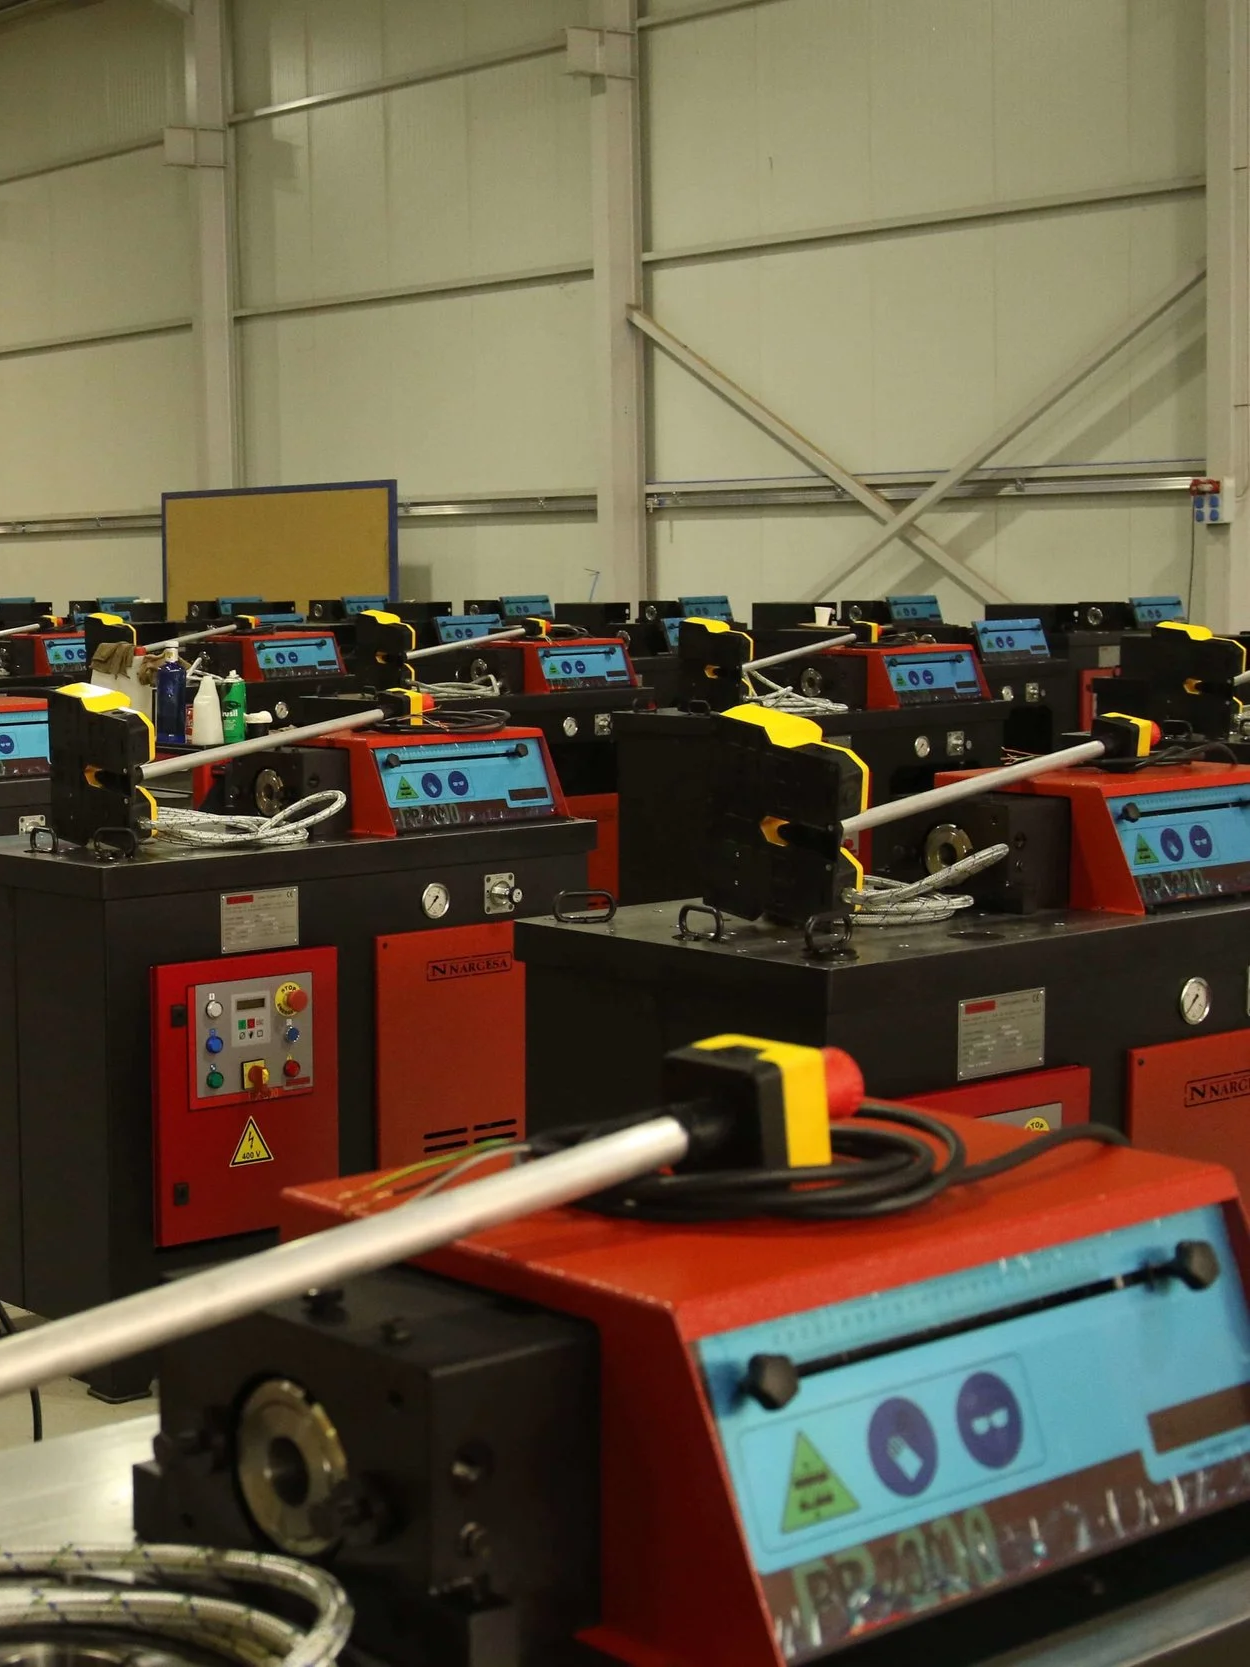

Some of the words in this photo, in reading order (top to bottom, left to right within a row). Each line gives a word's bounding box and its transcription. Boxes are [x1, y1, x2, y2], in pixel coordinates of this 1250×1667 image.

[450, 958, 508, 975] NARGESA
[1209, 1077, 1250, 1098] NARG
[242, 1151, 254, 1159] 400
